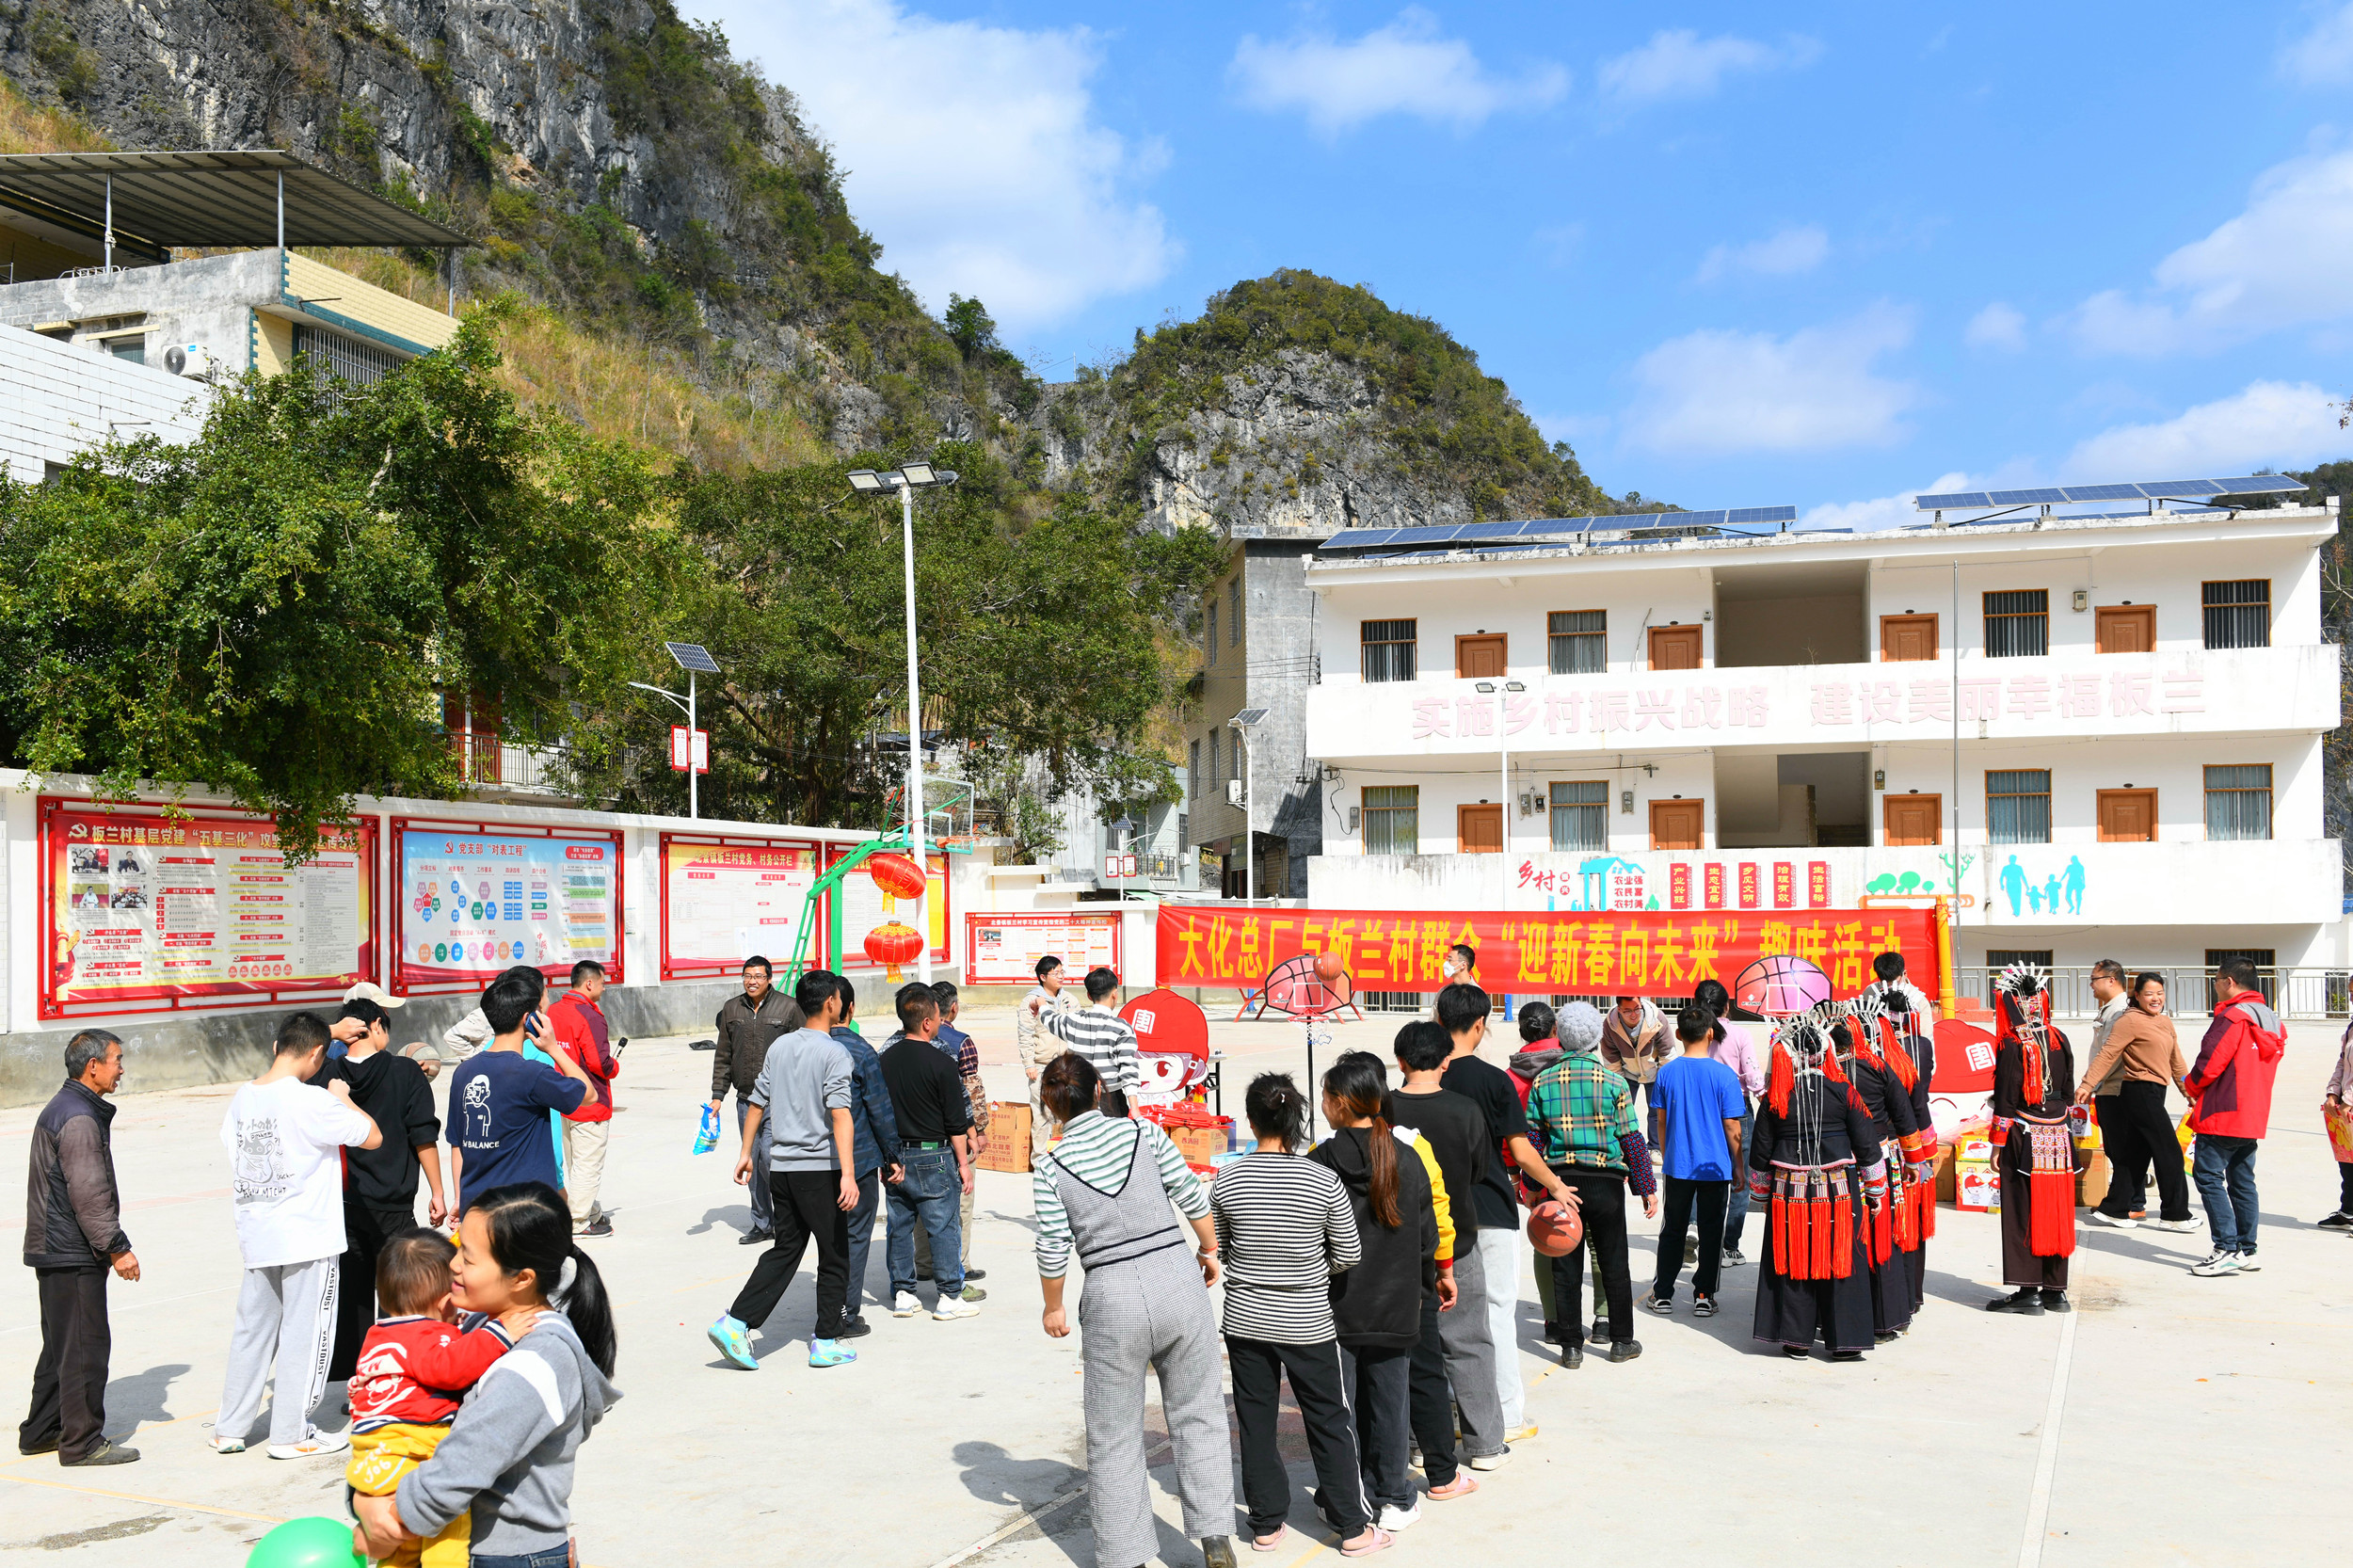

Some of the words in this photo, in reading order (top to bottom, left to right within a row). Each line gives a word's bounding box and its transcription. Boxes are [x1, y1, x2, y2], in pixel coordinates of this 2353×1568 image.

[1412, 685, 1770, 740] 实施乡村振兴战略
[1810, 669, 2206, 727] 建设美丽幸福板兰
[458, 841, 527, 856] 党支部“对表工程”
[1517, 859, 1557, 892] 乡村
[1614, 875, 1643, 886] 农业强
[1614, 888, 1643, 897] 农民富
[1673, 867, 1686, 904] 产业兴旺
[1708, 867, 1721, 904] 生态宜居
[1742, 866, 1754, 903] 乡风文明
[1777, 866, 1790, 903] 治理有效
[1812, 866, 1825, 902] 生活富裕
[1614, 899, 1643, 909] 农村美
[468, 1140, 500, 1149] BALANCE
